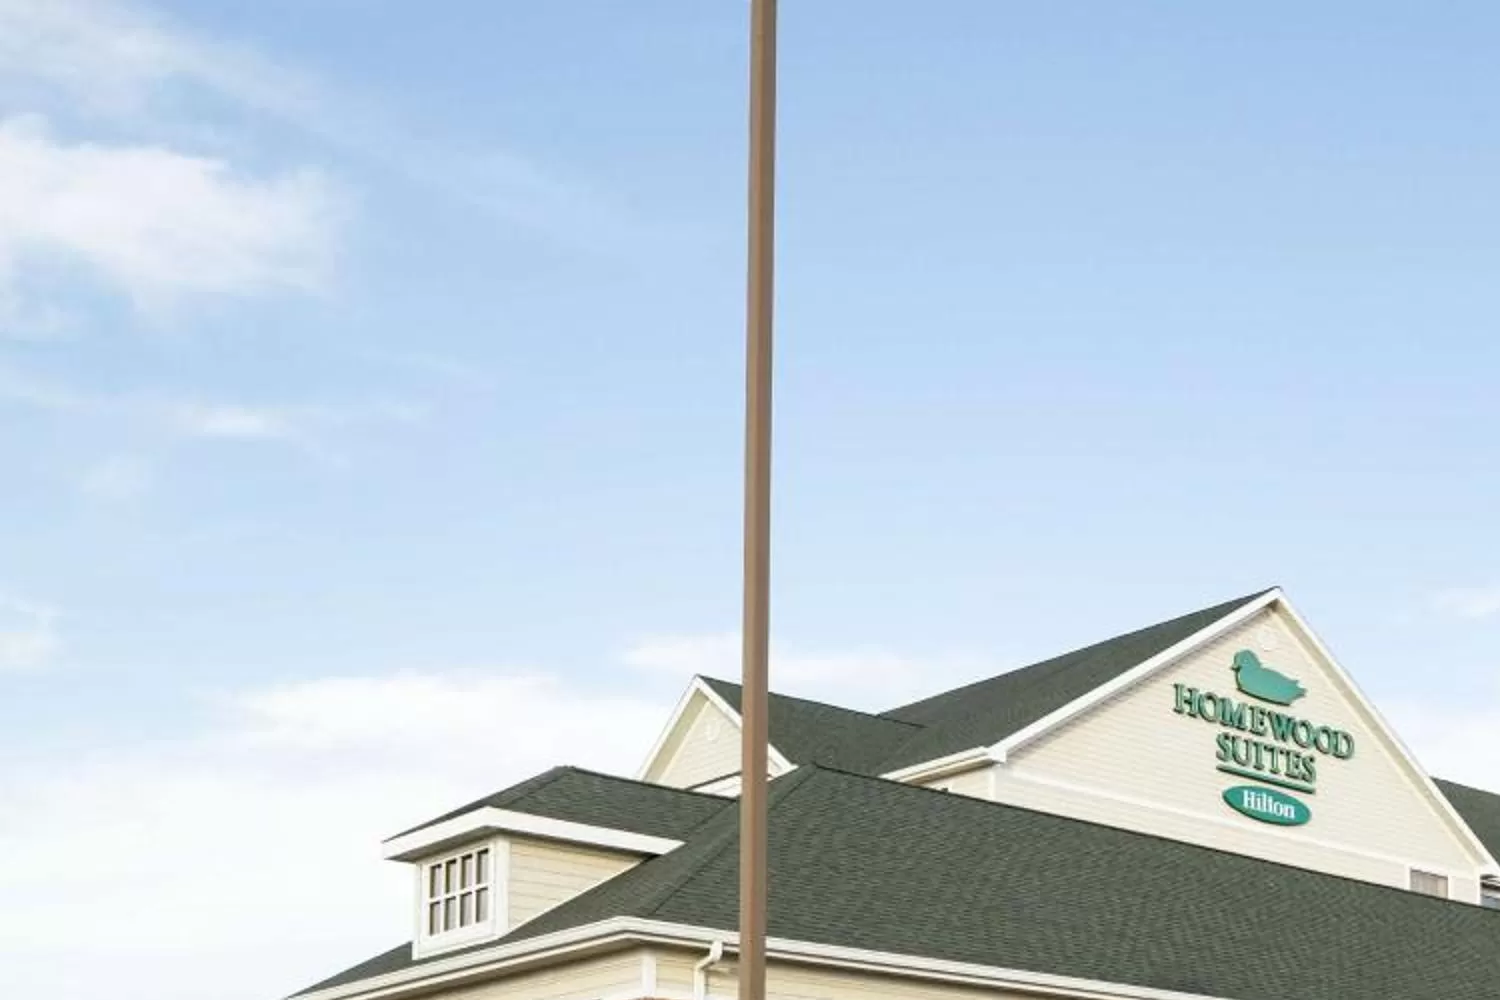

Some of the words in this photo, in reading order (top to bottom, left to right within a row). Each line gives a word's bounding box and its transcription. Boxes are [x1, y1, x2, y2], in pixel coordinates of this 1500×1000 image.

[1173, 683, 1355, 759] HOMEWOOD
[1216, 732, 1316, 783] SUITES
[1243, 790, 1295, 819] Hilton
